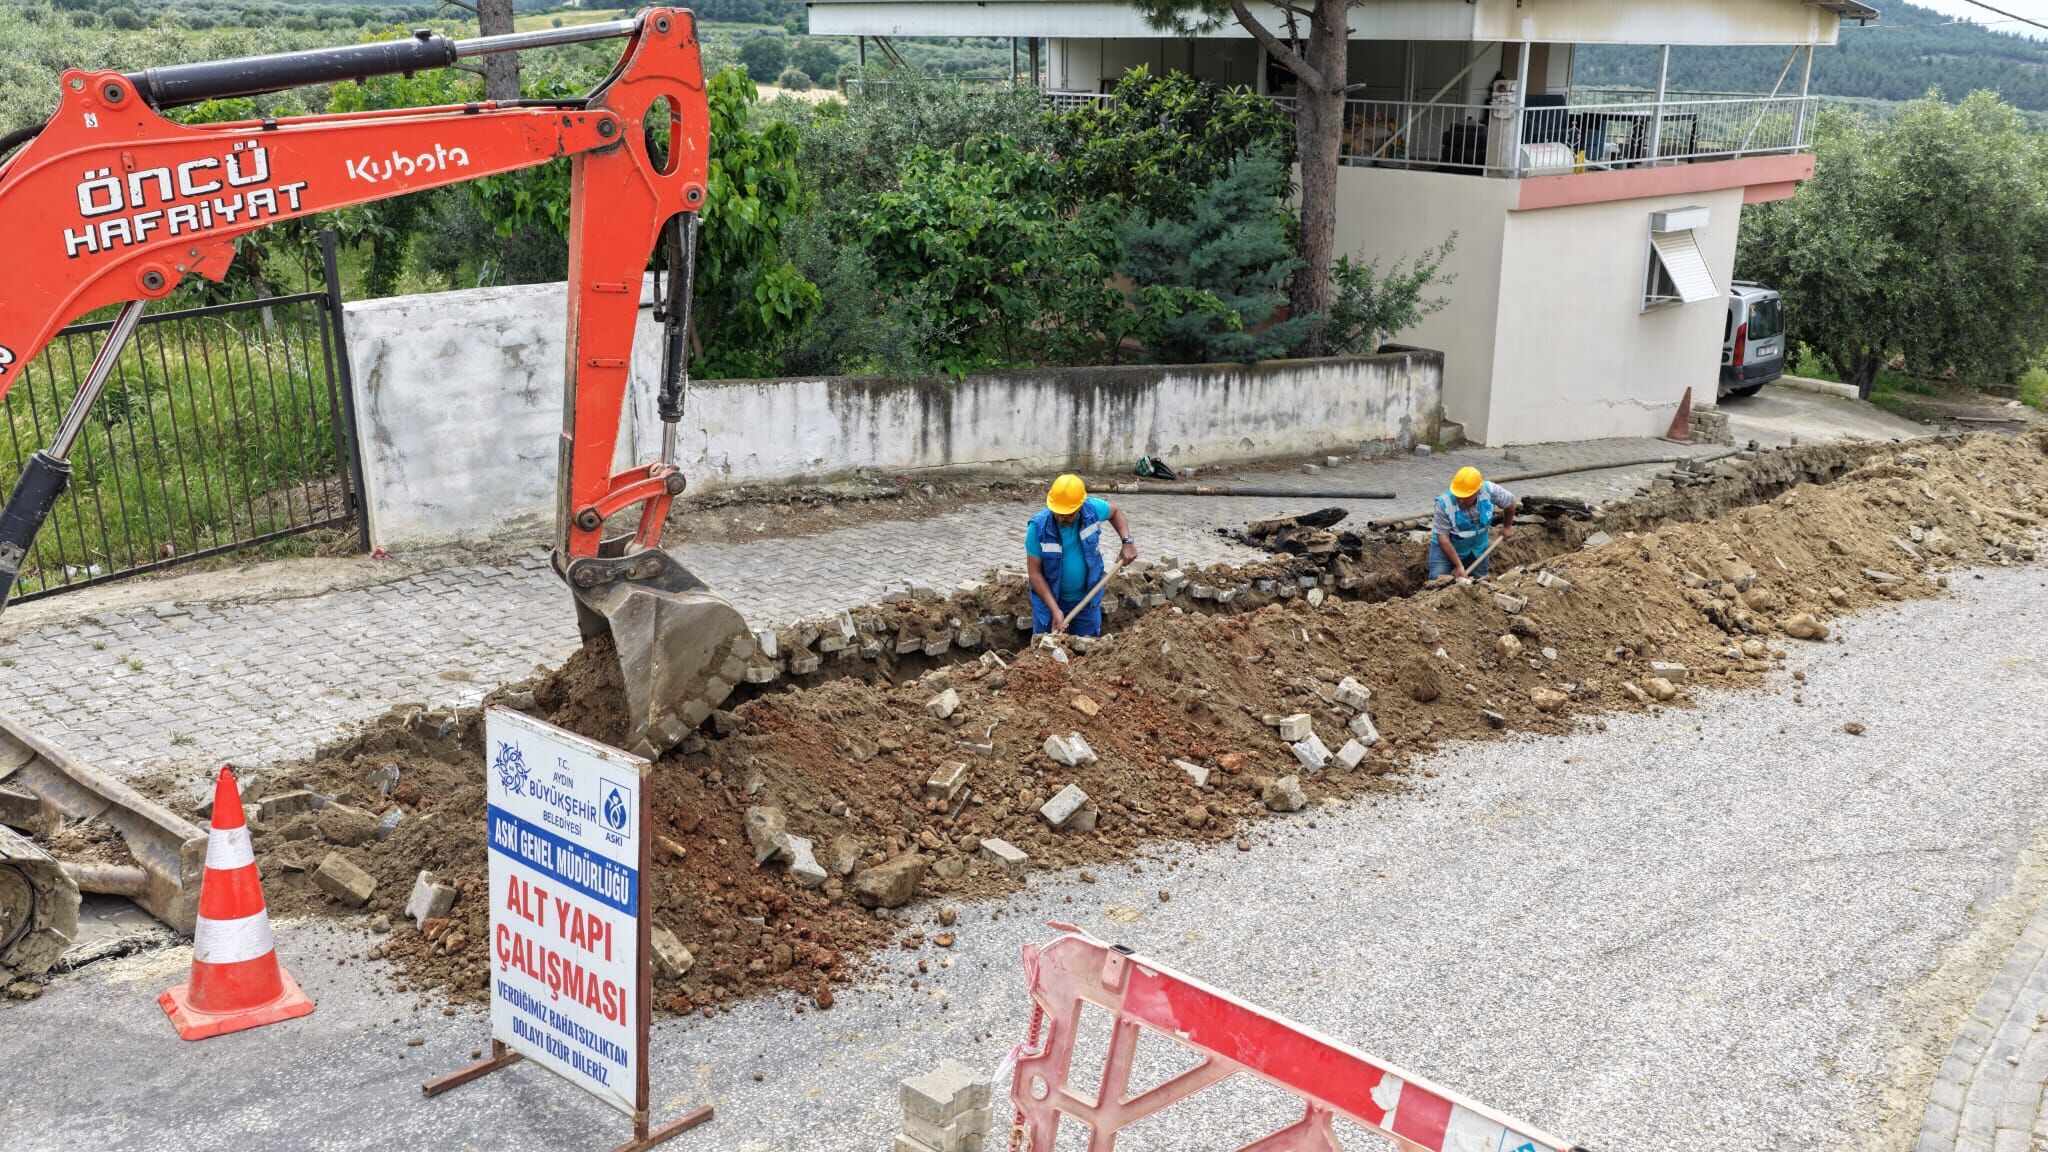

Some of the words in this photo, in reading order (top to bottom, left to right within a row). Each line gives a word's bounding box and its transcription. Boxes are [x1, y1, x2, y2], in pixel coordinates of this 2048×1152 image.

[75, 139, 271, 218] ÖNCÜ
[345, 143, 470, 183] Kubota
[552, 772, 574, 790] AYDIN
[557, 757, 570, 771] T.C.
[529, 779, 598, 825] BÜYÜKŞEHİR
[543, 810, 582, 837] BELEDİYESİ
[495, 817, 518, 853] ASKİ
[520, 829, 553, 870] GENEL
[556, 845, 629, 906] MÜDÜRLÜĞÜ
[605, 832, 623, 847] ASKİ
[507, 874, 548, 928] ALT
[555, 896, 612, 962] YAPI
[496, 923, 627, 1028] ÇALIŞMASI
[497, 979, 553, 1023] VERDİĞİMİZ
[549, 1009, 628, 1068] RAHATSIZLIKTAN
[512, 1016, 544, 1050] DOLAYI
[546, 1032, 570, 1067] ÖZÜR
[572, 1052, 611, 1088] DİLERİZ.
